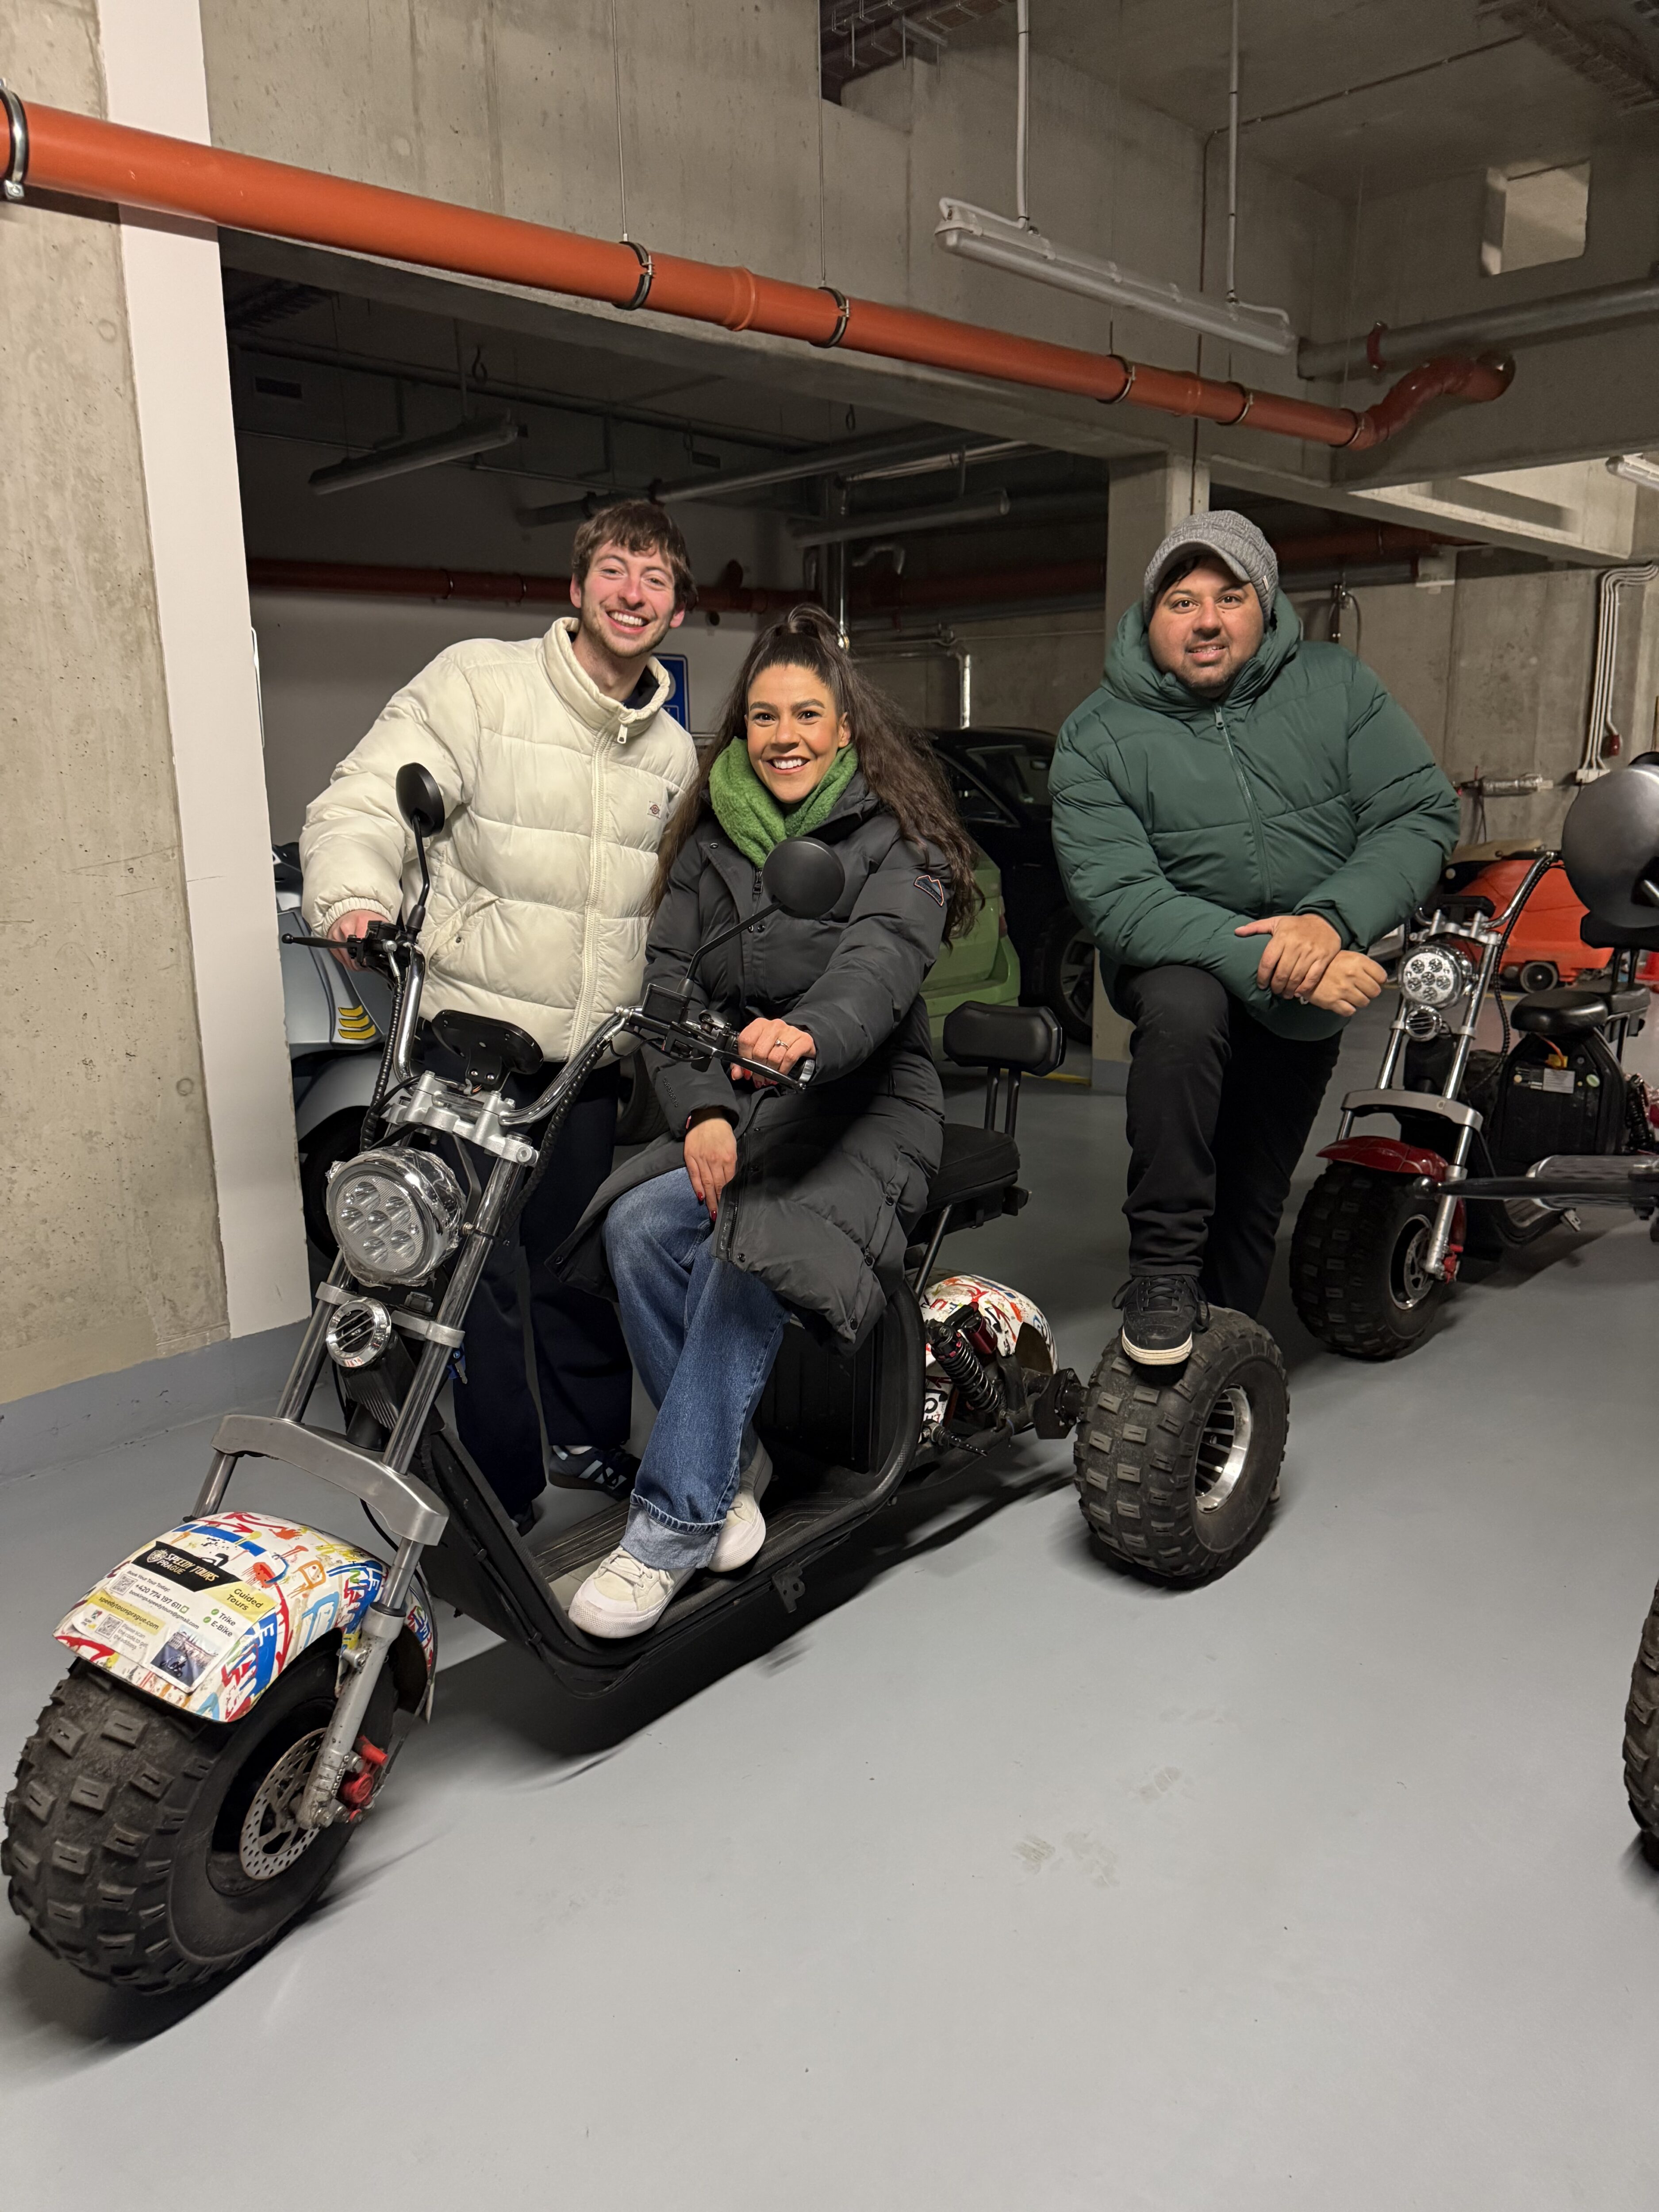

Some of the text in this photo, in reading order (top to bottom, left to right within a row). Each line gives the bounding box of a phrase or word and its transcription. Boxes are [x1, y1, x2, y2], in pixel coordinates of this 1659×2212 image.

[156, 1559, 186, 1575] PRAGUE
[165, 1553, 220, 1582] SPEEDY TOURS
[135, 1583, 150, 1594] +420
[150, 1589, 161, 1599] 774
[161, 1595, 172, 1604] 197
[227, 1594, 249, 1611] Tours
[234, 1589, 263, 1608] Guided
[99, 1597, 159, 1630] speedytoursprague.com
[219, 1613, 236, 1626] Trike
[211, 1621, 232, 1637] E-Bike
